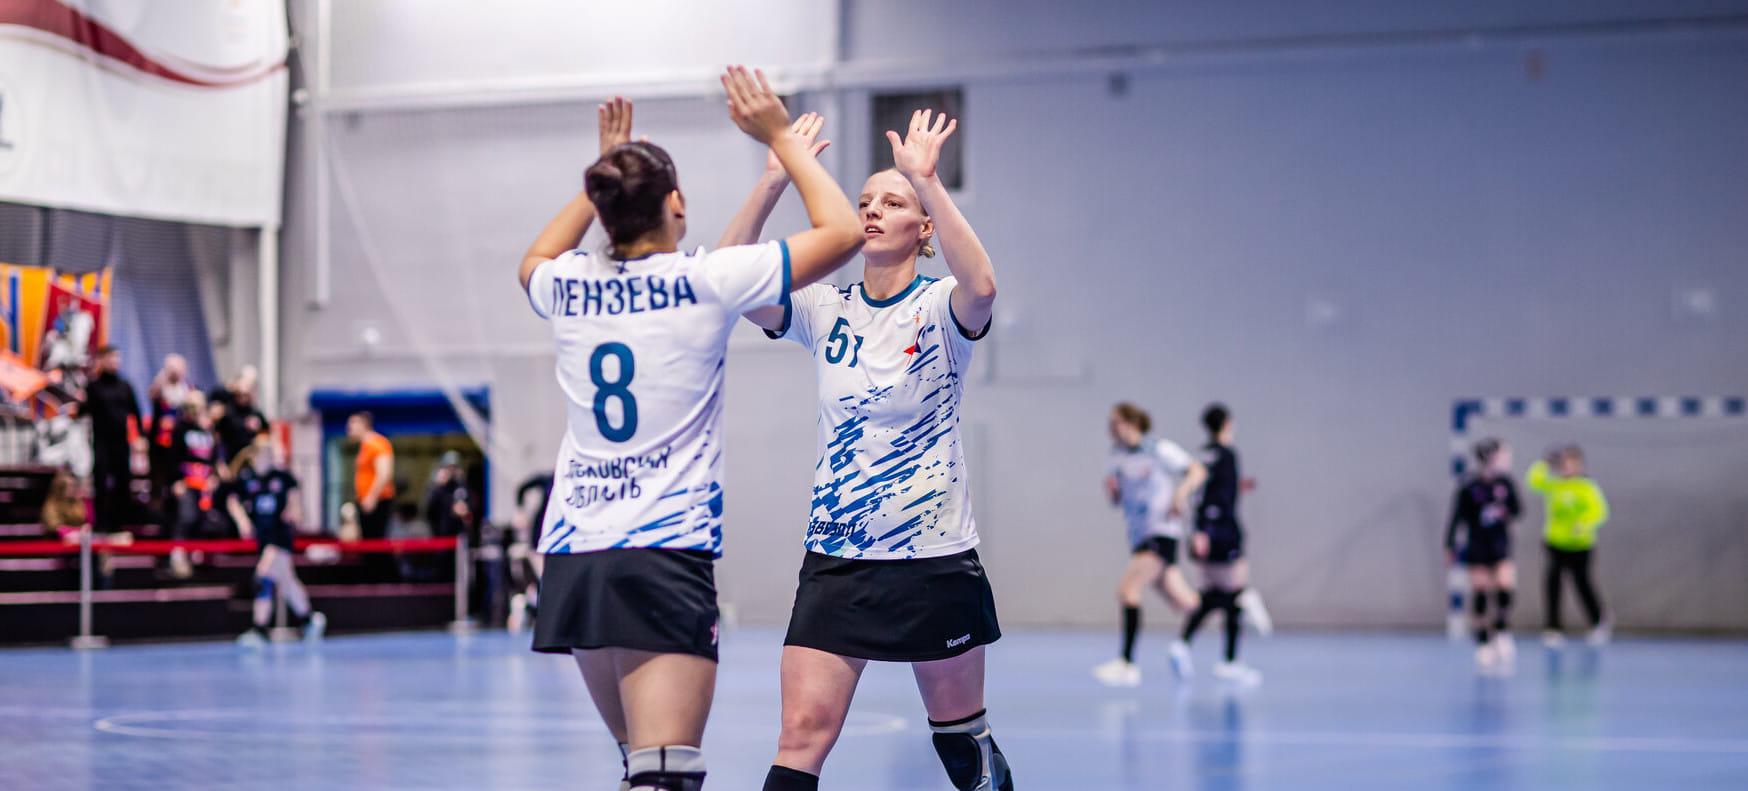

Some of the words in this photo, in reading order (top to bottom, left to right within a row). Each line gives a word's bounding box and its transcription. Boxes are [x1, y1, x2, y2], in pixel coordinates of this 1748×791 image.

[825, 316, 864, 368] 51
[588, 341, 638, 443] 8
[946, 633, 971, 648] Kempa
